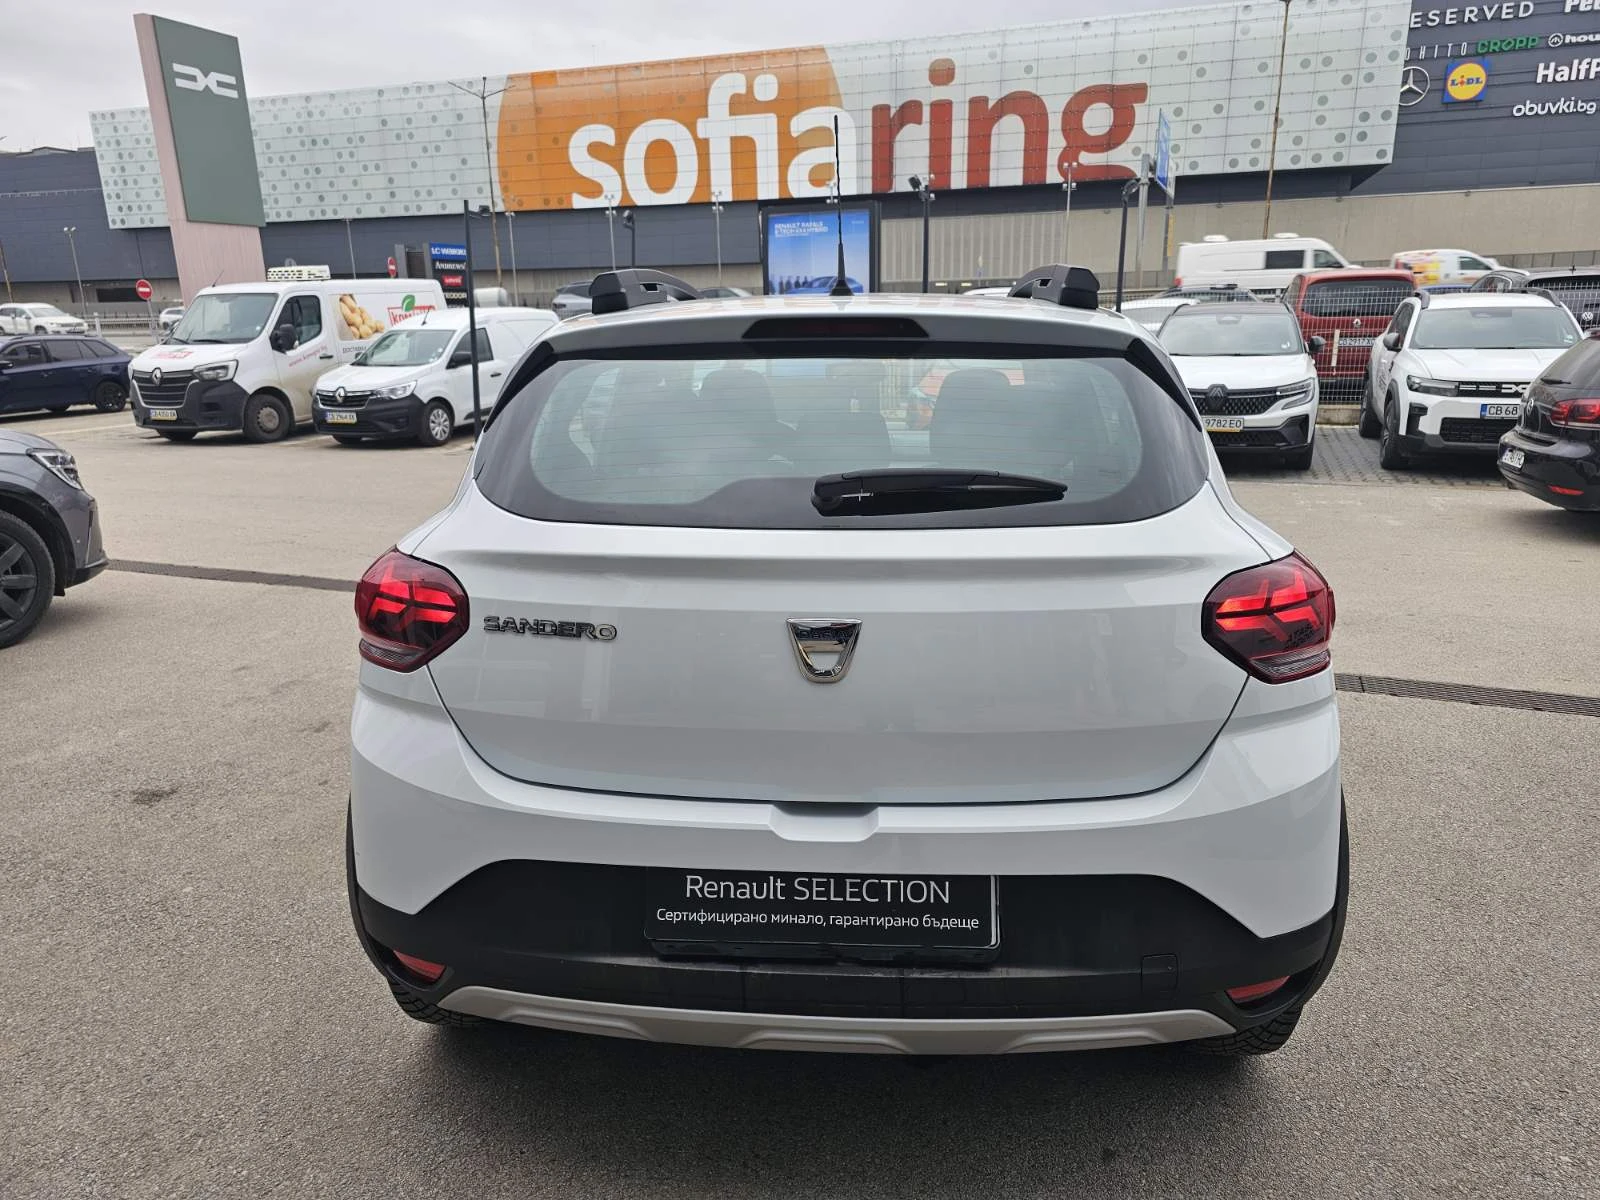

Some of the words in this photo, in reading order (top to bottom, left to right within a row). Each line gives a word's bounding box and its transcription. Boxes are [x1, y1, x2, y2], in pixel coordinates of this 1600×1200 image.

[1477, 36, 1540, 53] CROPP
[1536, 57, 1600, 83] HalfP
[1512, 96, 1597, 117] obuvki.bg
[1488, 405, 1503, 416] CB
[1504, 406, 1518, 416] 68
[1205, 418, 1228, 428] 9782
[483, 615, 617, 641] SANDERO
[685, 875, 786, 900] Renault
[794, 877, 950, 904] SELECTION
[656, 908, 768, 926] Сертифицирано
[771, 912, 827, 927] минало,
[829, 914, 919, 929] гарантирано
[922, 914, 980, 931] бъдеще
